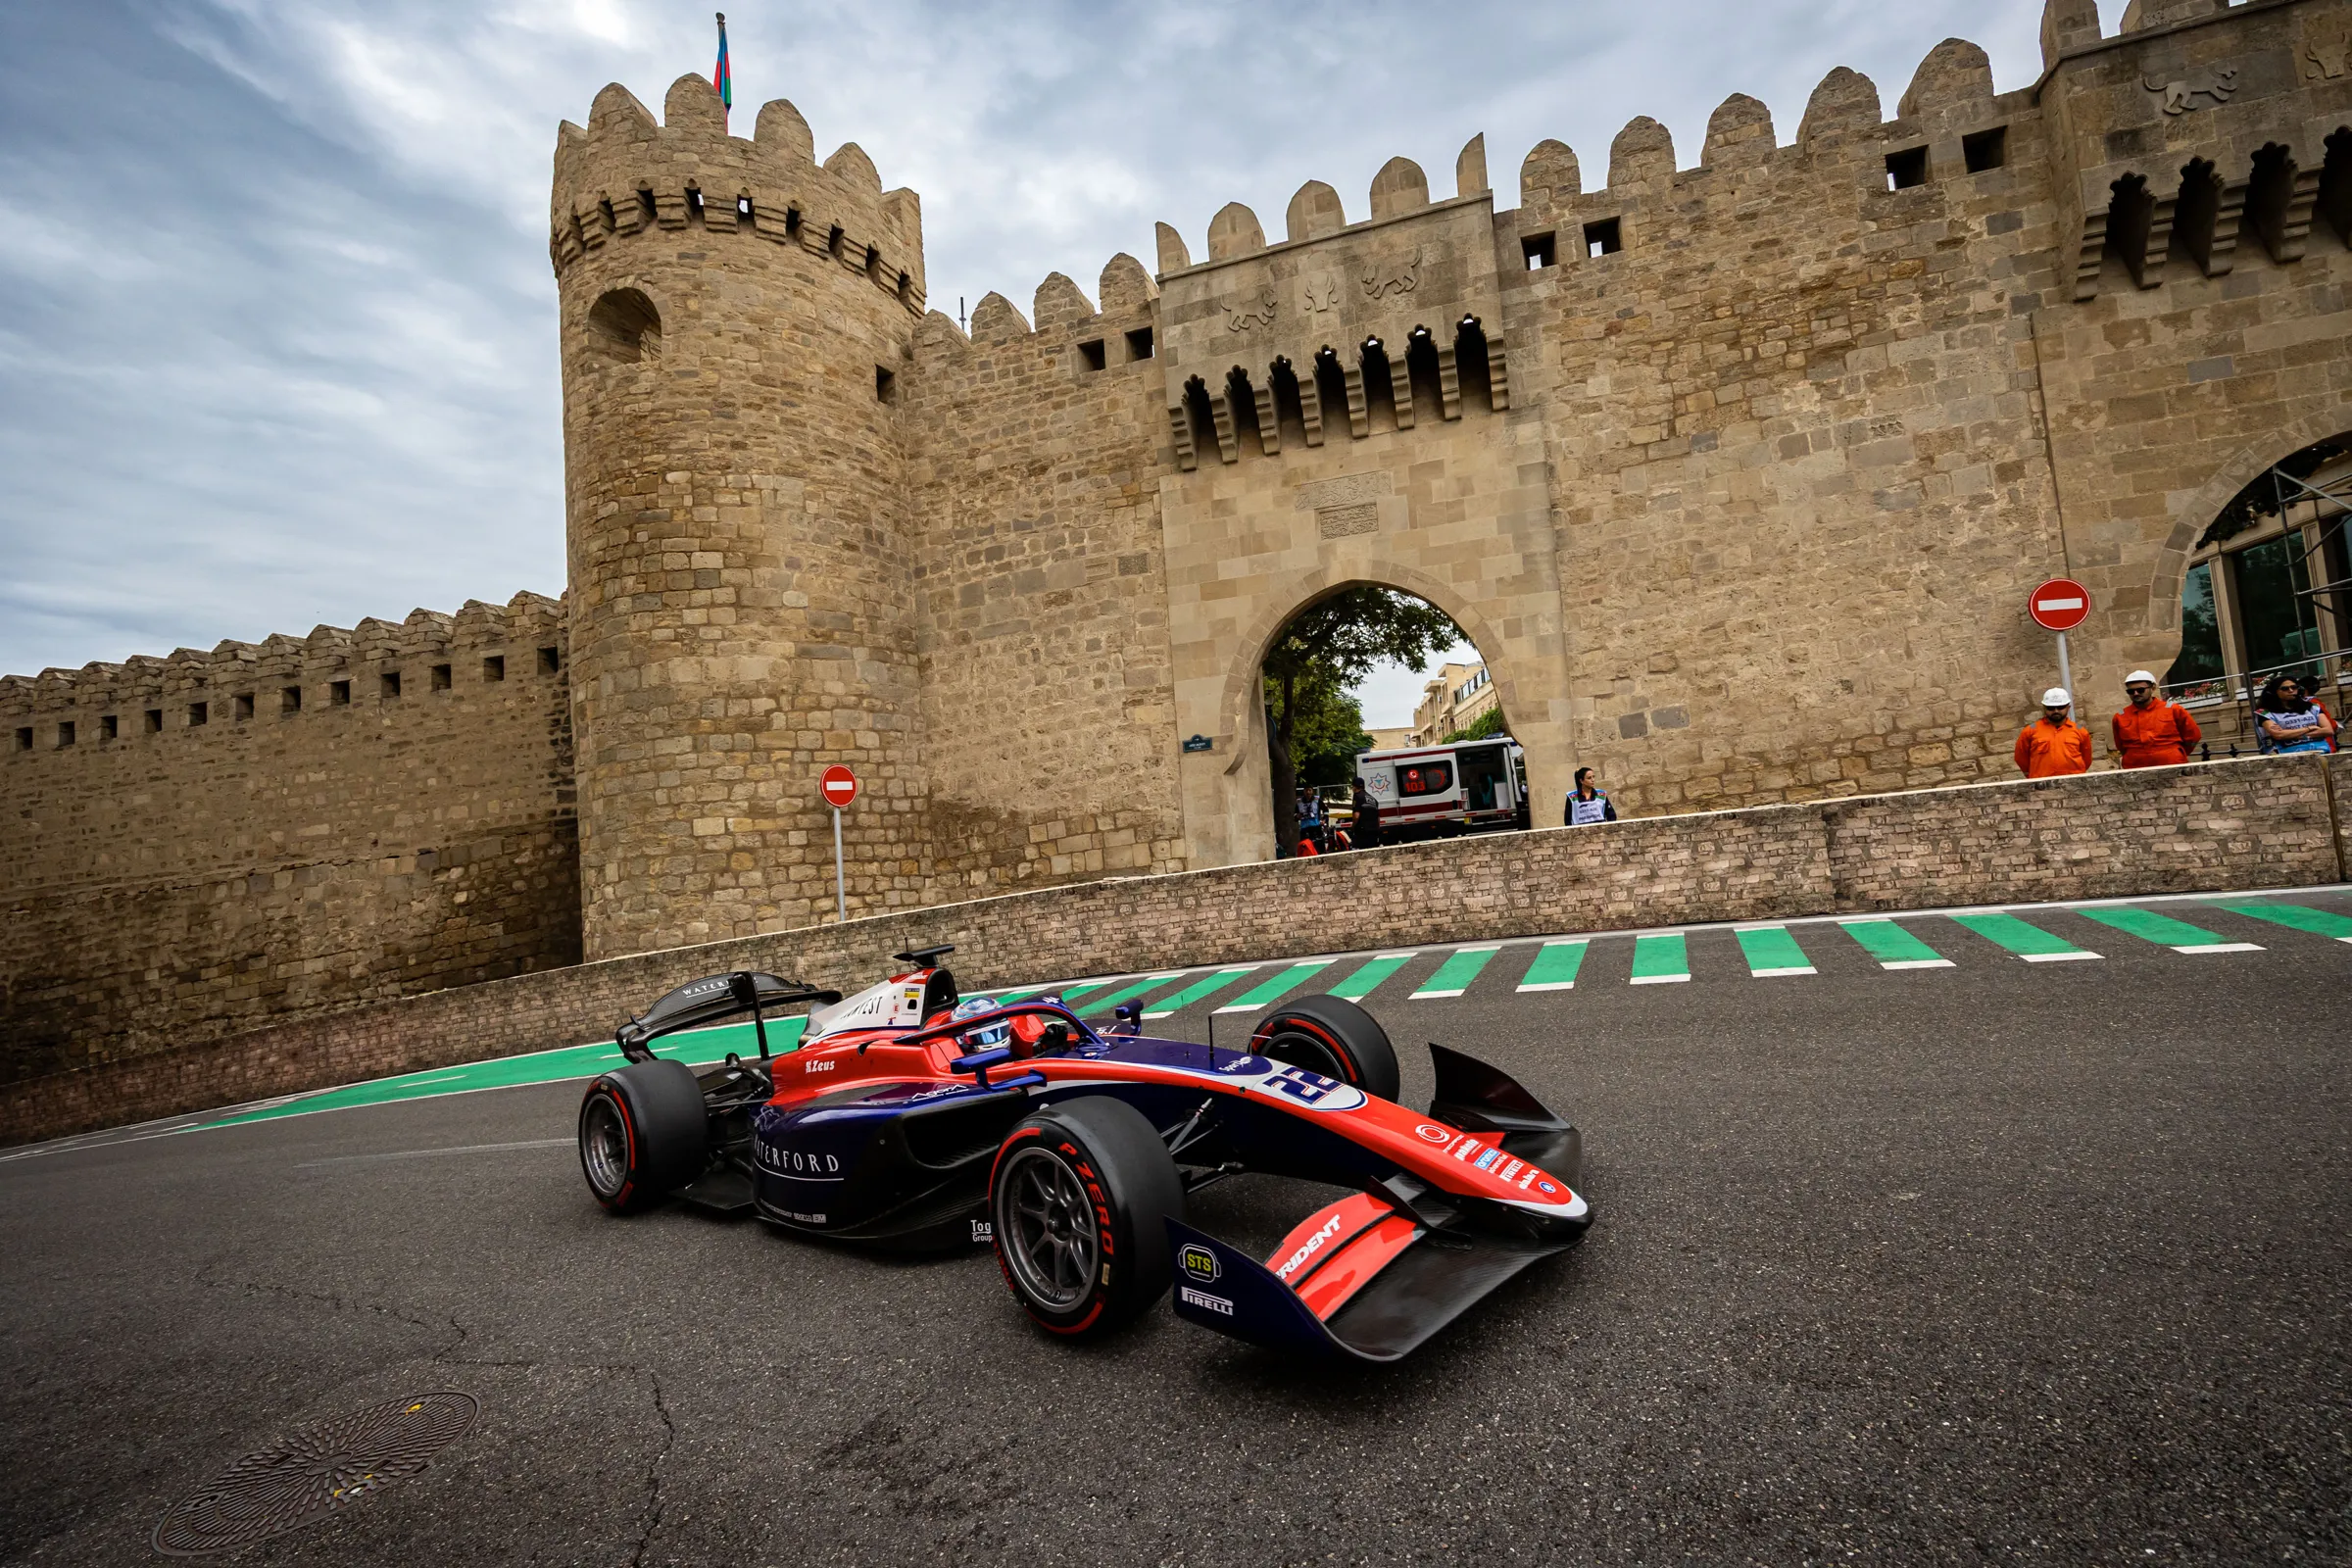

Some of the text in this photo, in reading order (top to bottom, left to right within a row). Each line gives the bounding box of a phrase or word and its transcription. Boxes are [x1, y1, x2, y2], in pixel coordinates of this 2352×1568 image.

[1404, 781, 1426, 792] 103
[683, 980, 729, 996] WATER
[812, 1060, 835, 1072] Zeus
[1262, 1067, 1345, 1104] 22
[1499, 1159, 1524, 1183] PIRELLI
[1076, 1161, 1114, 1255] ZERO
[970, 1219, 992, 1234] Tog
[1187, 1253, 1211, 1271] STS
[1181, 1286, 1233, 1316] PIRELLI
